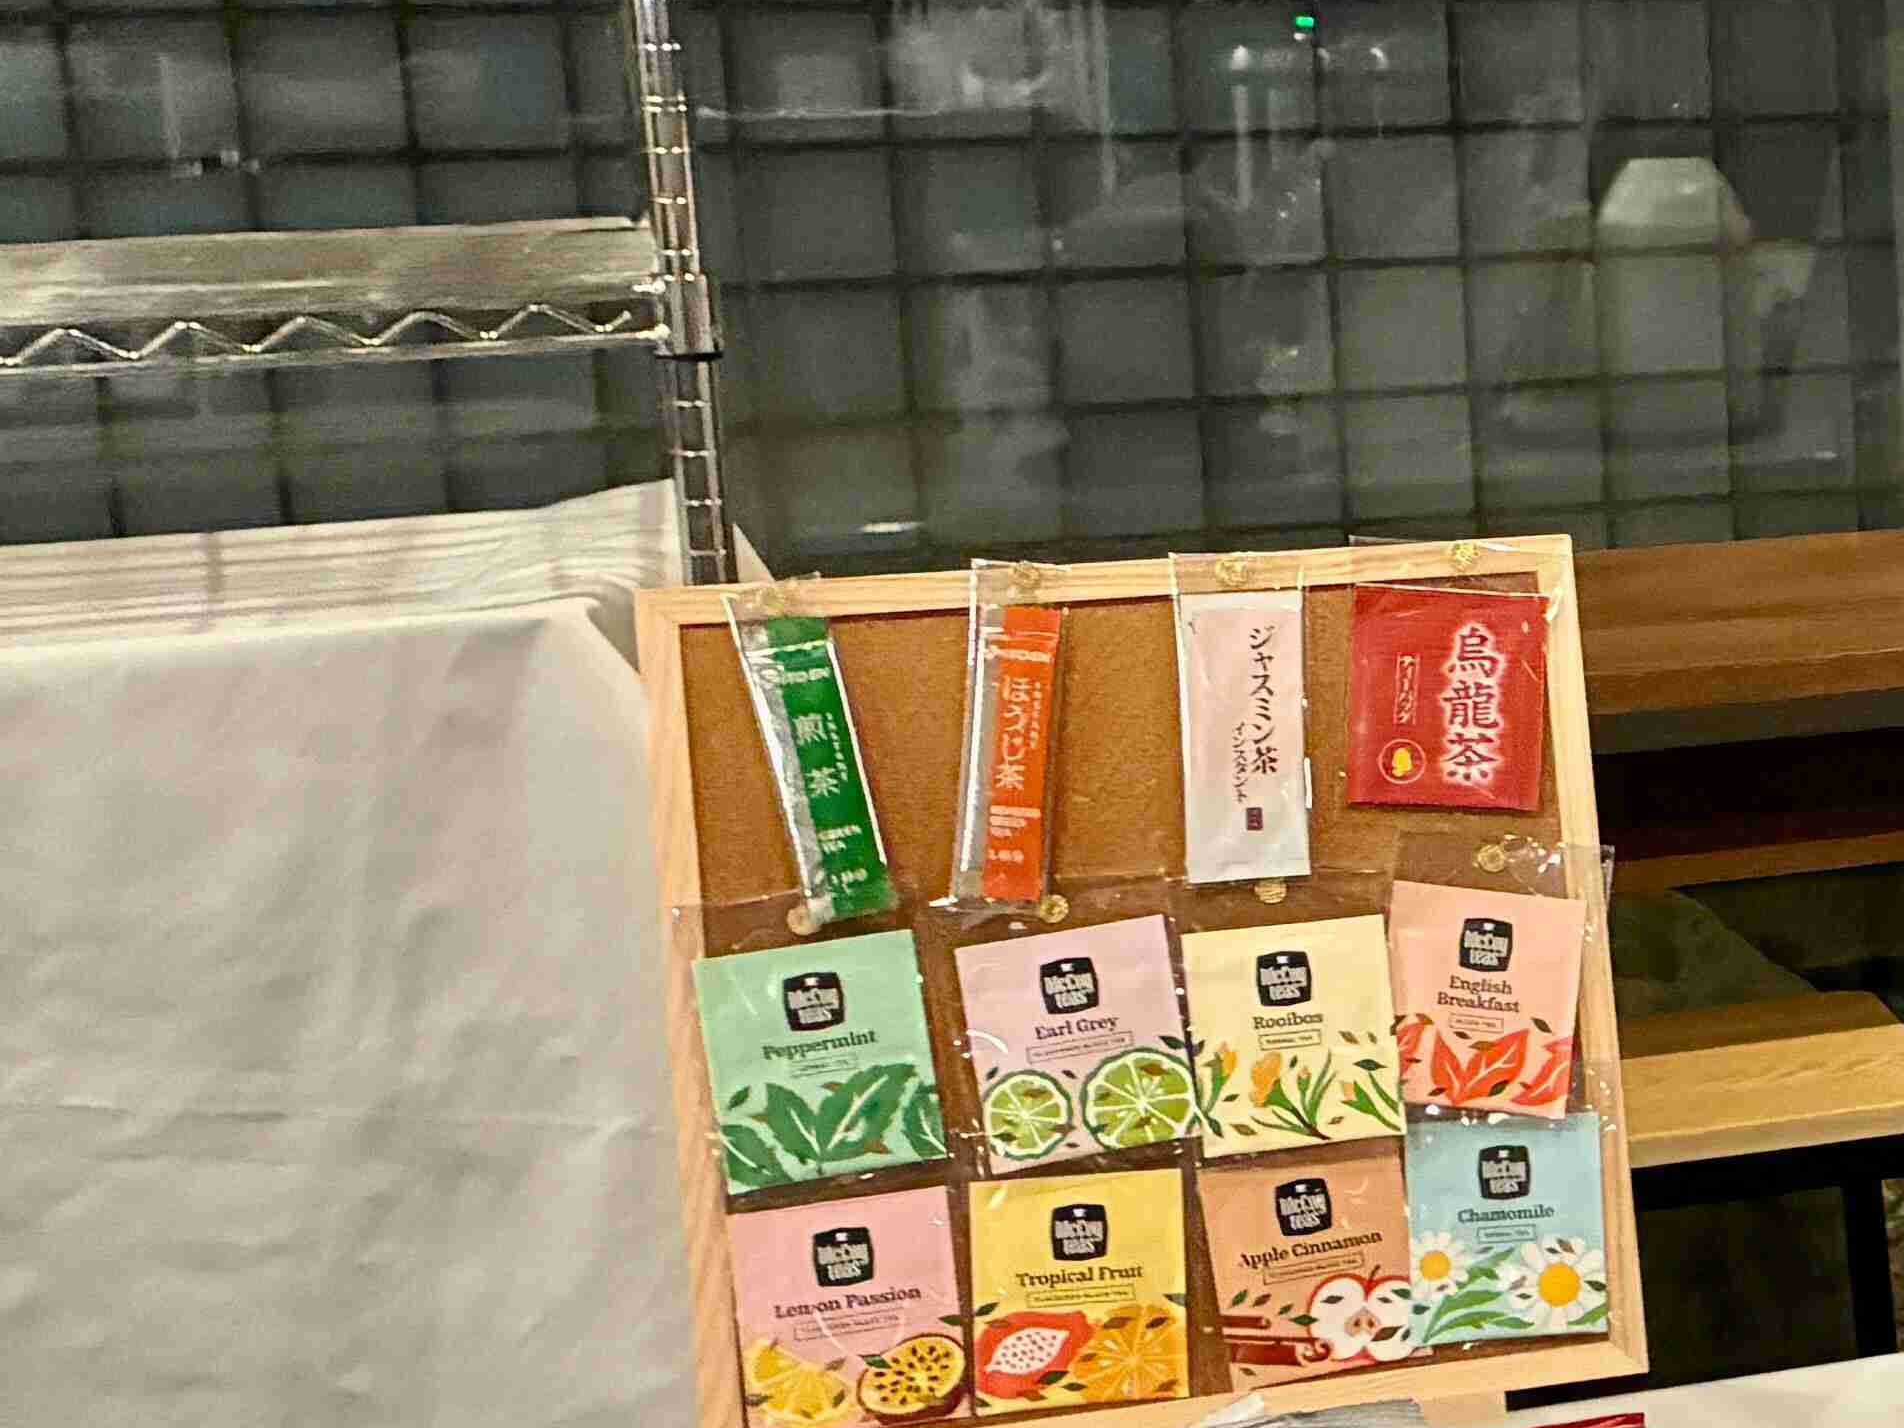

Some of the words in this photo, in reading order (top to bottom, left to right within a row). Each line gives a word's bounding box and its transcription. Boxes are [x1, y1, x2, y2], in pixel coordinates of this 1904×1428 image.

[1249, 624, 1279, 775] ジャスミン茶
[1441, 624, 1502, 782] 烏龍茶
[1449, 975, 1512, 996] English
[1437, 993, 1521, 1014] Breakfast
[1034, 1021, 1072, 1041] Earl
[1076, 1015, 1120, 1038] Grey
[1253, 1010, 1323, 1030] Rooibos
[762, 1029, 878, 1062] Peppermint
[1457, 1204, 1554, 1223] Chamomile
[1239, 1246, 1288, 1270] Apple
[1292, 1231, 1383, 1258] Cinnamon
[1015, 1267, 1094, 1289] Tropical
[1098, 1264, 1144, 1283] Fruit
[773, 1297, 840, 1320] Lemon
[845, 1286, 922, 1310] Passion
